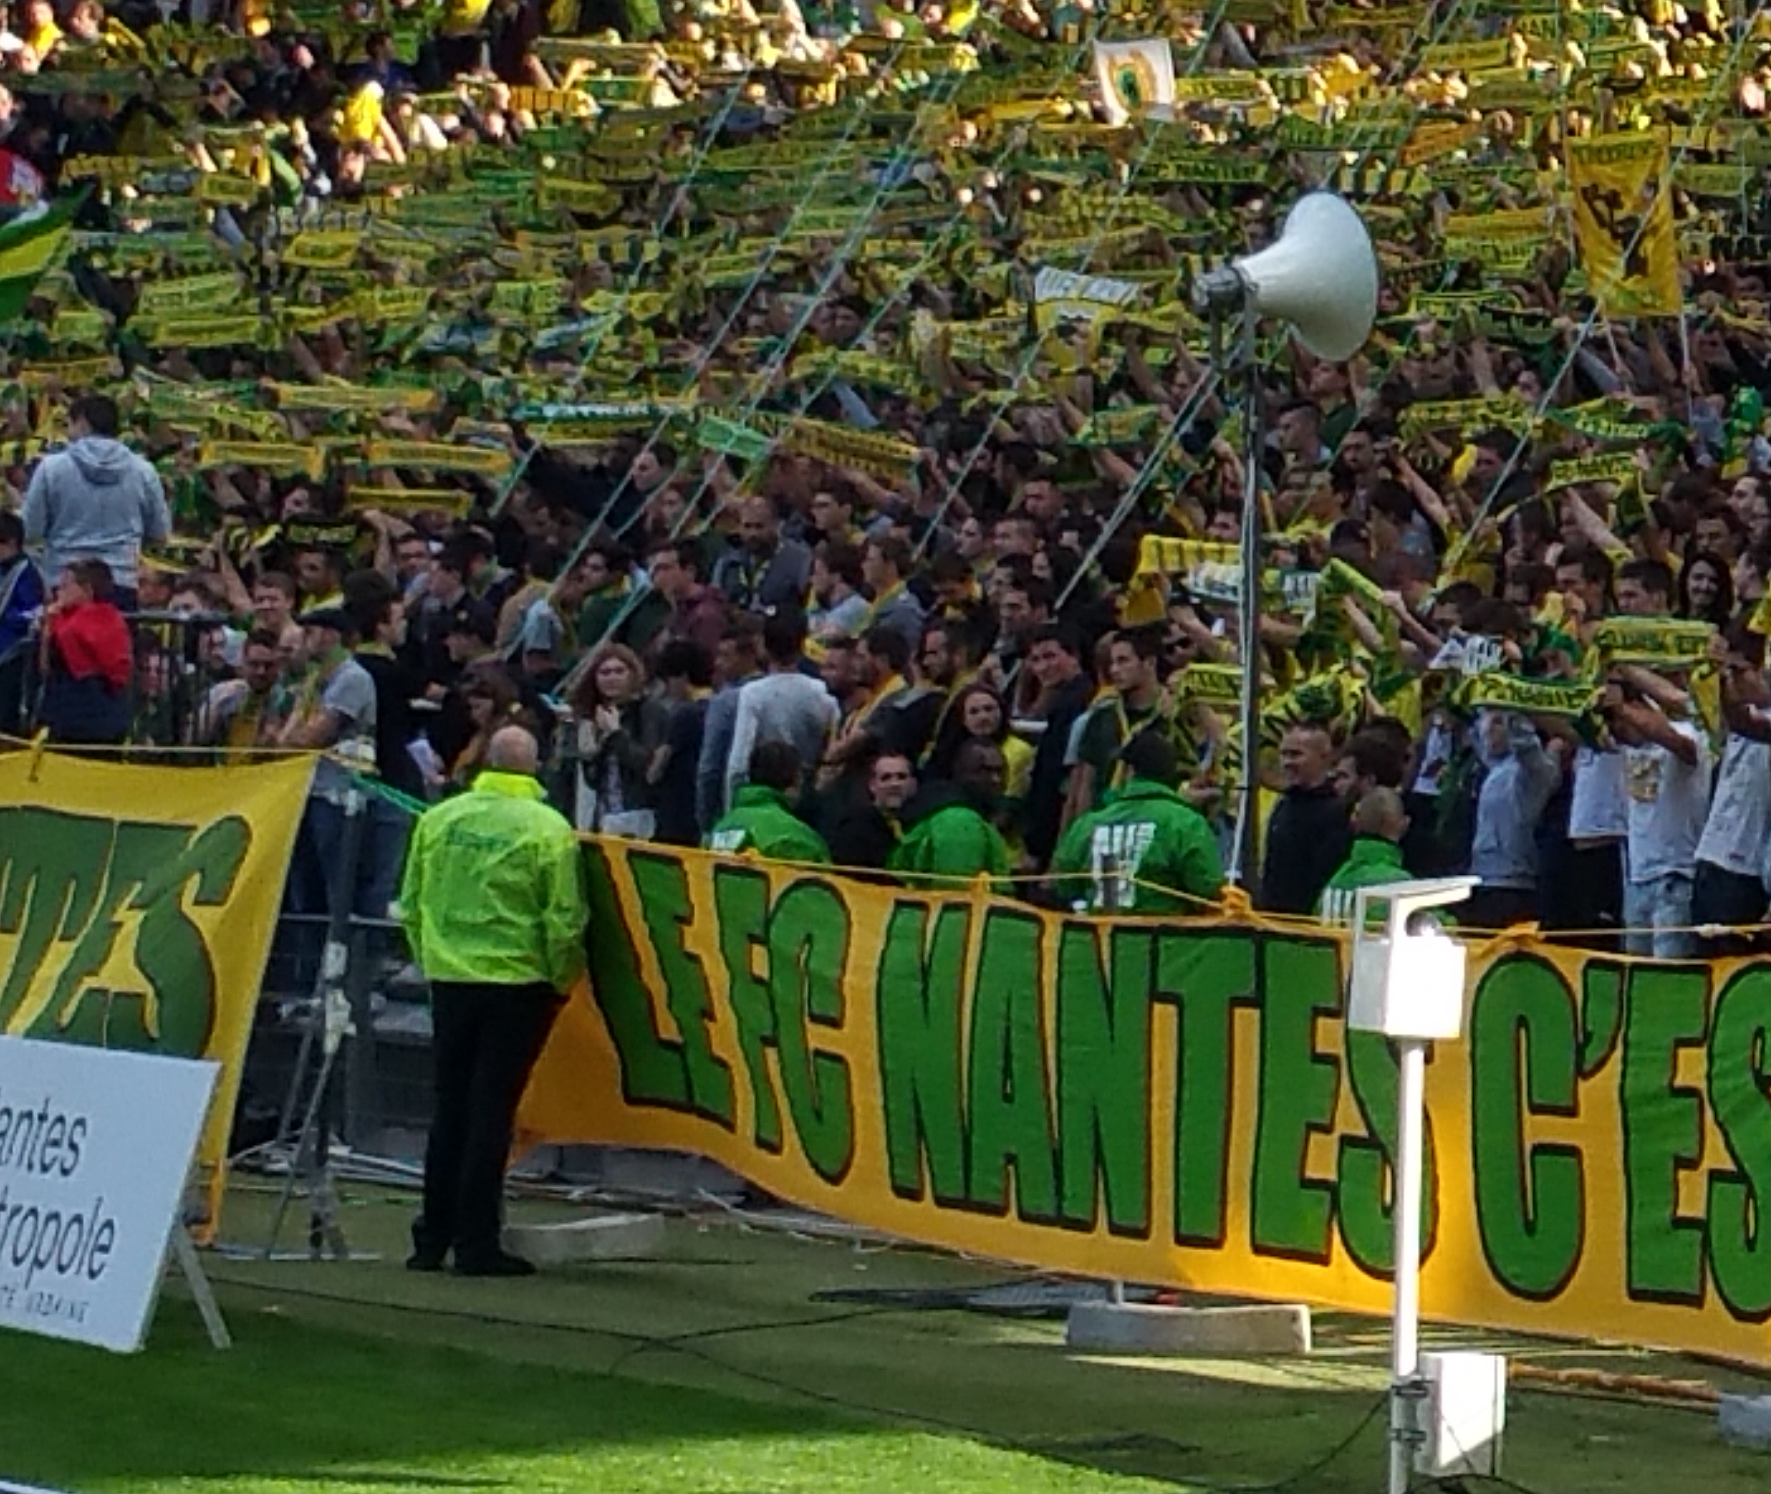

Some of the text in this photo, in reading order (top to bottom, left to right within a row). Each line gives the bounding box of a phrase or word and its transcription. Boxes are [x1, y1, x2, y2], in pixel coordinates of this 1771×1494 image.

[583, 846, 737, 1136] LE
[713, 861, 855, 1188] FC
[875, 896, 1442, 1284] NANTES
